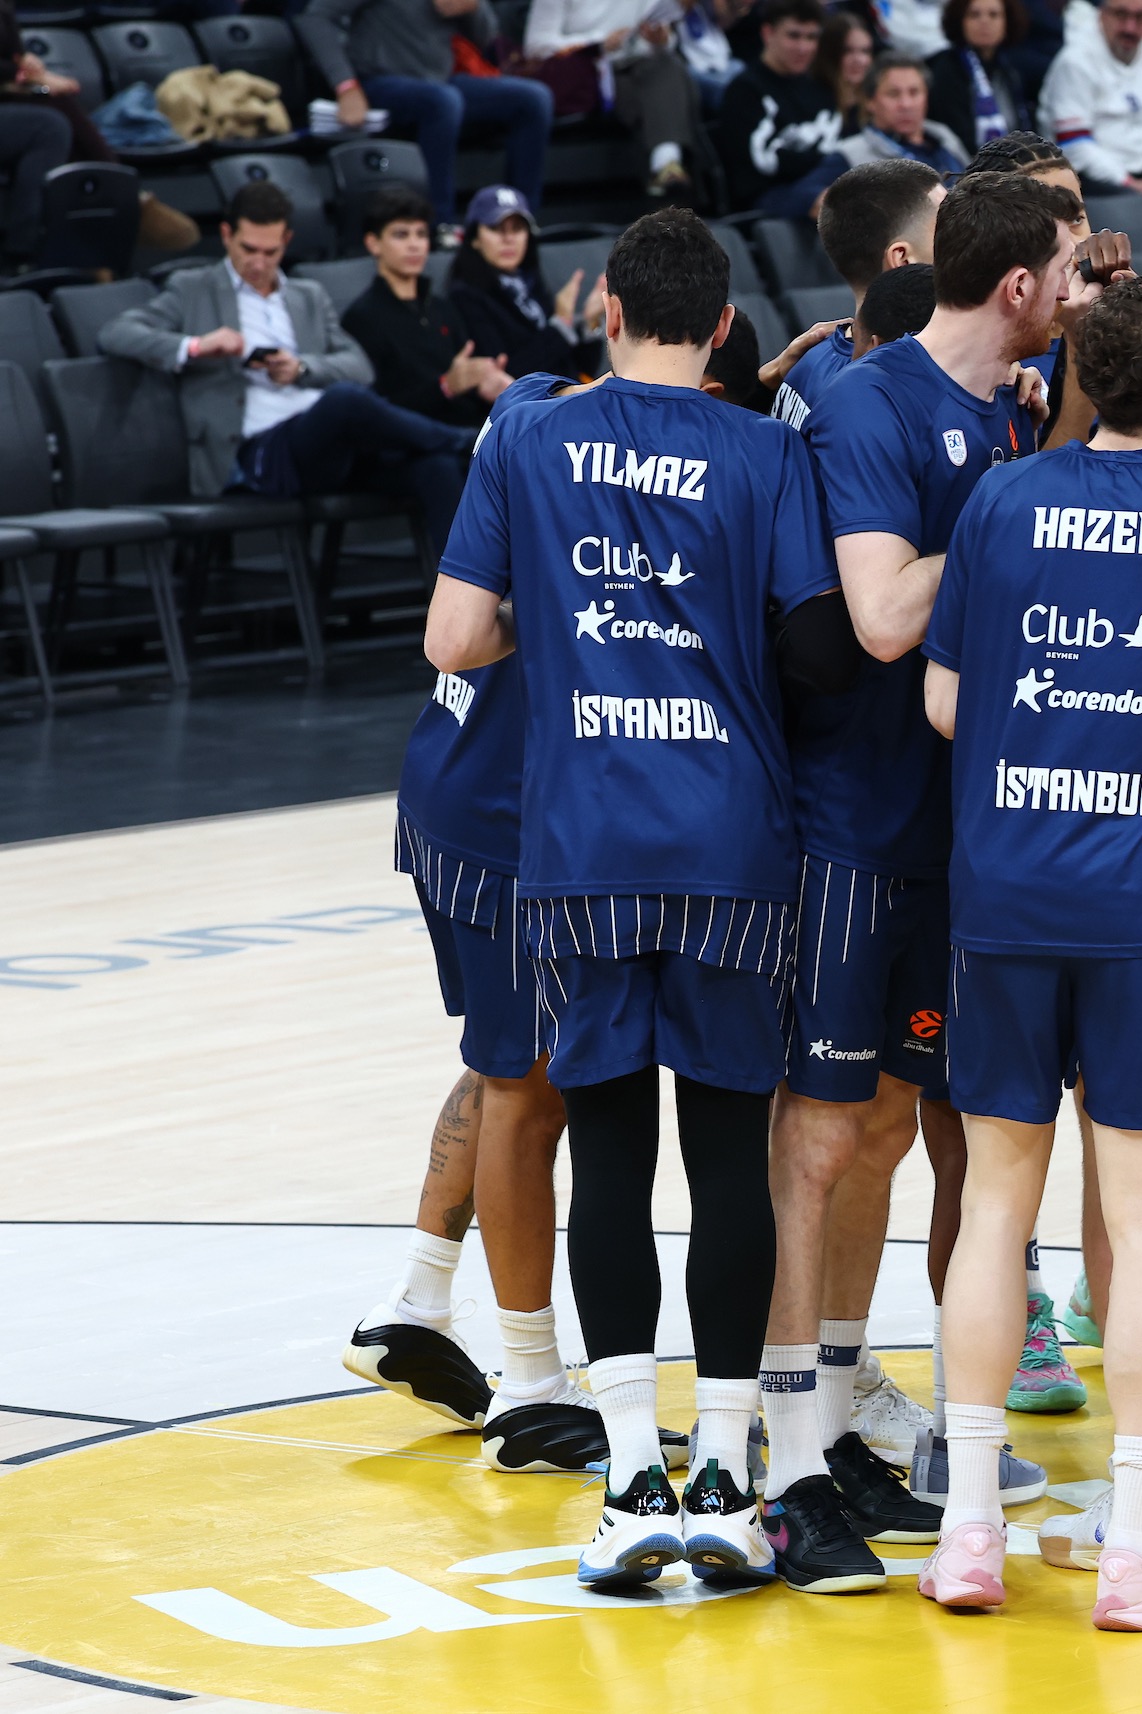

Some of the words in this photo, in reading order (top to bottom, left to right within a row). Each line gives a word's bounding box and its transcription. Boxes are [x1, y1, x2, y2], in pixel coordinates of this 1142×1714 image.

[562, 441, 708, 501] YILMAZ
[572, 536, 653, 582] Club
[604, 582, 635, 590] BEYMEN
[1022, 603, 1115, 648] Club
[1045, 651, 1080, 661] BEYMEN
[572, 689, 730, 743] İSTANBUL
[827, 1049, 877, 1061] corendon
